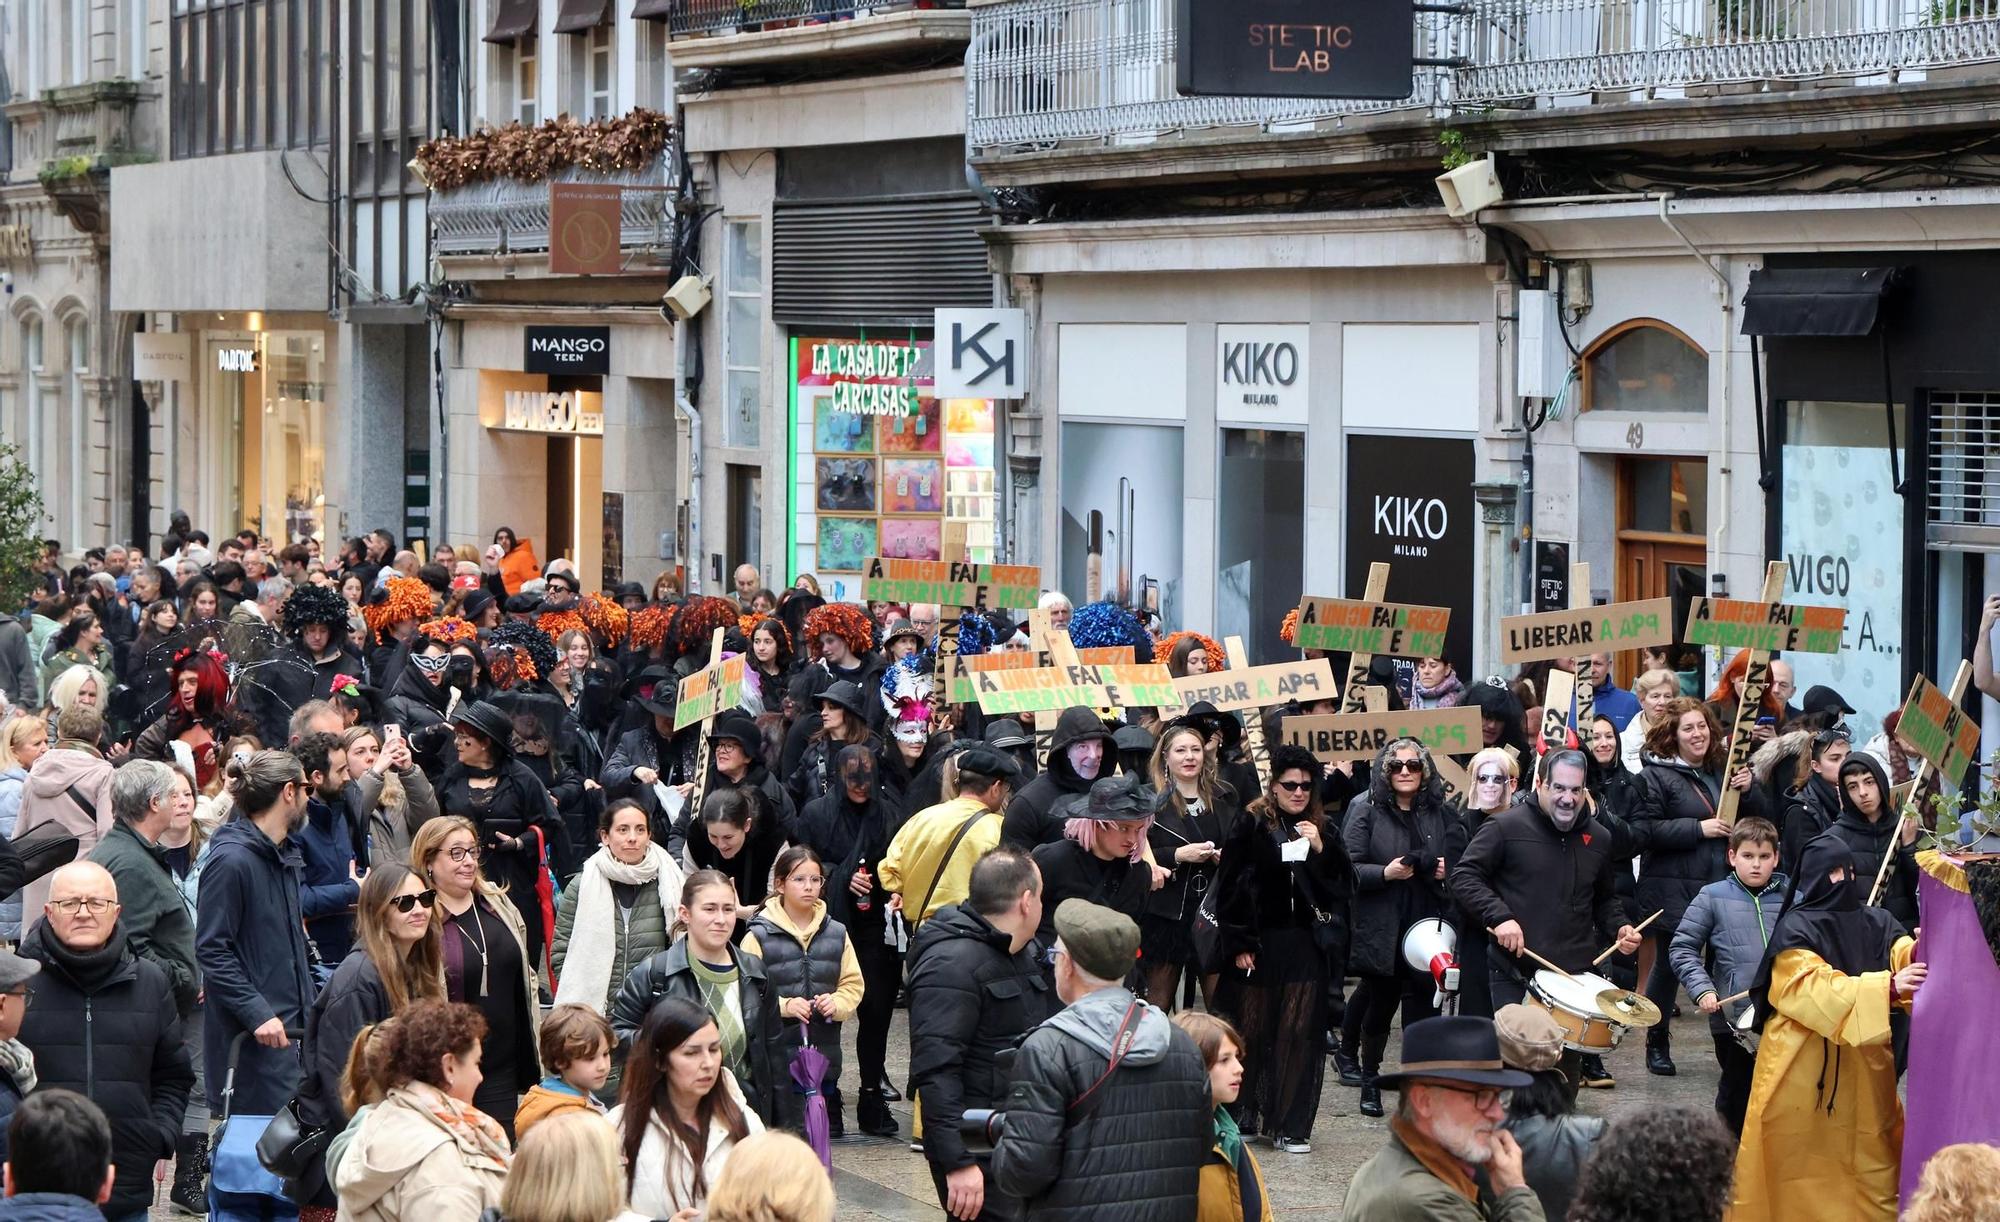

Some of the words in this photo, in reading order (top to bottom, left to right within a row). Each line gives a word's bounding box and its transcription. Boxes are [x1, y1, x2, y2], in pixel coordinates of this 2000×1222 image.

[1269, 49, 1331, 72] LAB
[532, 338, 605, 352] MANGO
[554, 353, 584, 362] TEEN
[219, 349, 256, 372] PARFOIS
[811, 344, 832, 376] LA
[838, 344, 877, 377] CASA
[879, 345, 899, 378] DE
[1223, 342, 1299, 386] KIKO
[505, 390, 576, 431] MANGO
[832, 381, 910, 418] CARCASAS
[1242, 394, 1278, 406] MILANO
[1626, 422, 1643, 449] 49
[1374, 495, 1447, 540] KIKO
[1394, 545, 1428, 557] MILANO
[869, 558, 883, 579] A
[951, 563, 978, 584] FAI
[1788, 554, 1850, 597] VIGO
[867, 580, 966, 606] BEMBRIVE
[976, 586, 988, 608] E
[1545, 589, 1558, 600] LAB
[1303, 602, 1315, 624] A
[1372, 606, 1397, 628] FAI
[1696, 598, 1709, 620] A
[1769, 602, 1793, 625] FAI
[1300, 625, 1383, 652] BEMBRIVE
[1390, 630, 1402, 652] E
[1510, 621, 1593, 651] LIBERAR
[1600, 619, 1614, 641] A
[1619, 613, 1660, 639] AP9
[1786, 628, 1799, 651] E
[953, 656, 968, 678] A
[979, 672, 998, 692] A
[1067, 665, 1102, 686] FAI
[1258, 677, 1273, 699] A
[1278, 672, 1320, 696] AP9
[1577, 660, 1593, 721] NON
[1737, 662, 1767, 723] NON
[984, 686, 1096, 713] BEMBRIVE
[1106, 686, 1123, 708] E
[1036, 730, 1053, 772] NO
[1243, 713, 1271, 763] NON
